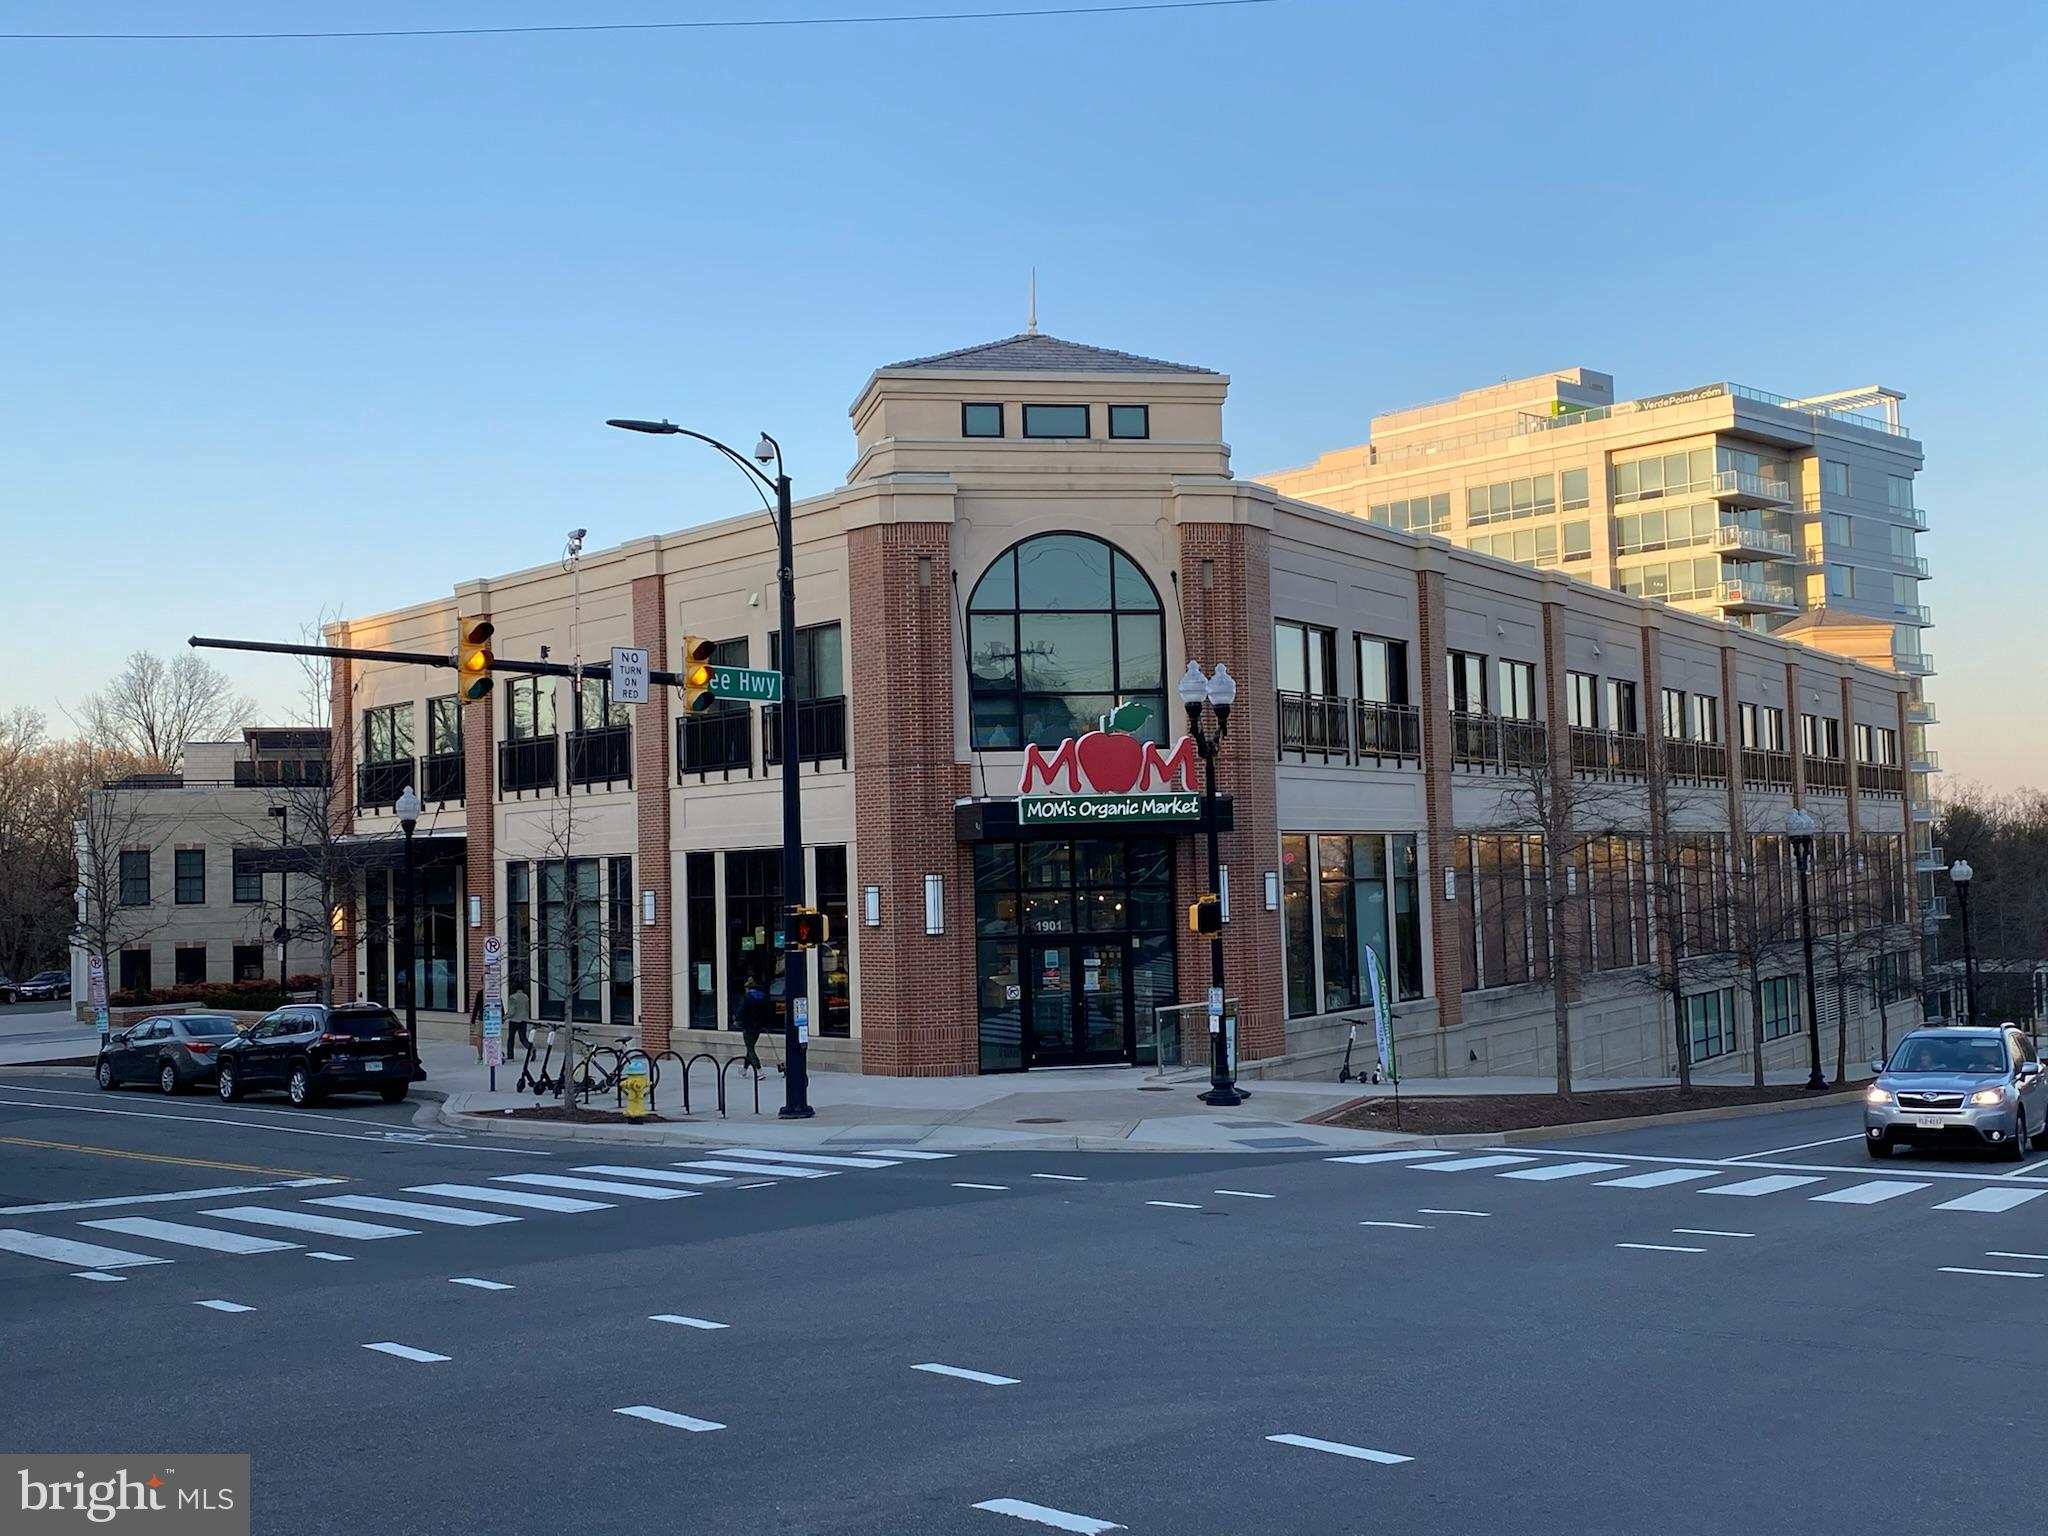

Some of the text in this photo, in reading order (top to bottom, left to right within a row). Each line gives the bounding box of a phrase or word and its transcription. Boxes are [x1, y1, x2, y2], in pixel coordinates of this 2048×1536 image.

[1643, 388, 1722, 411] VerdePointe.com
[621, 652, 639, 663] NO
[620, 666, 642, 675] TURN
[624, 677, 637, 687] ON
[709, 671, 776, 699] ee Hwy
[622, 689, 639, 699] RED
[1027, 795, 1200, 818] MOM's Organic Market
[1035, 920, 1063, 931] 1901
